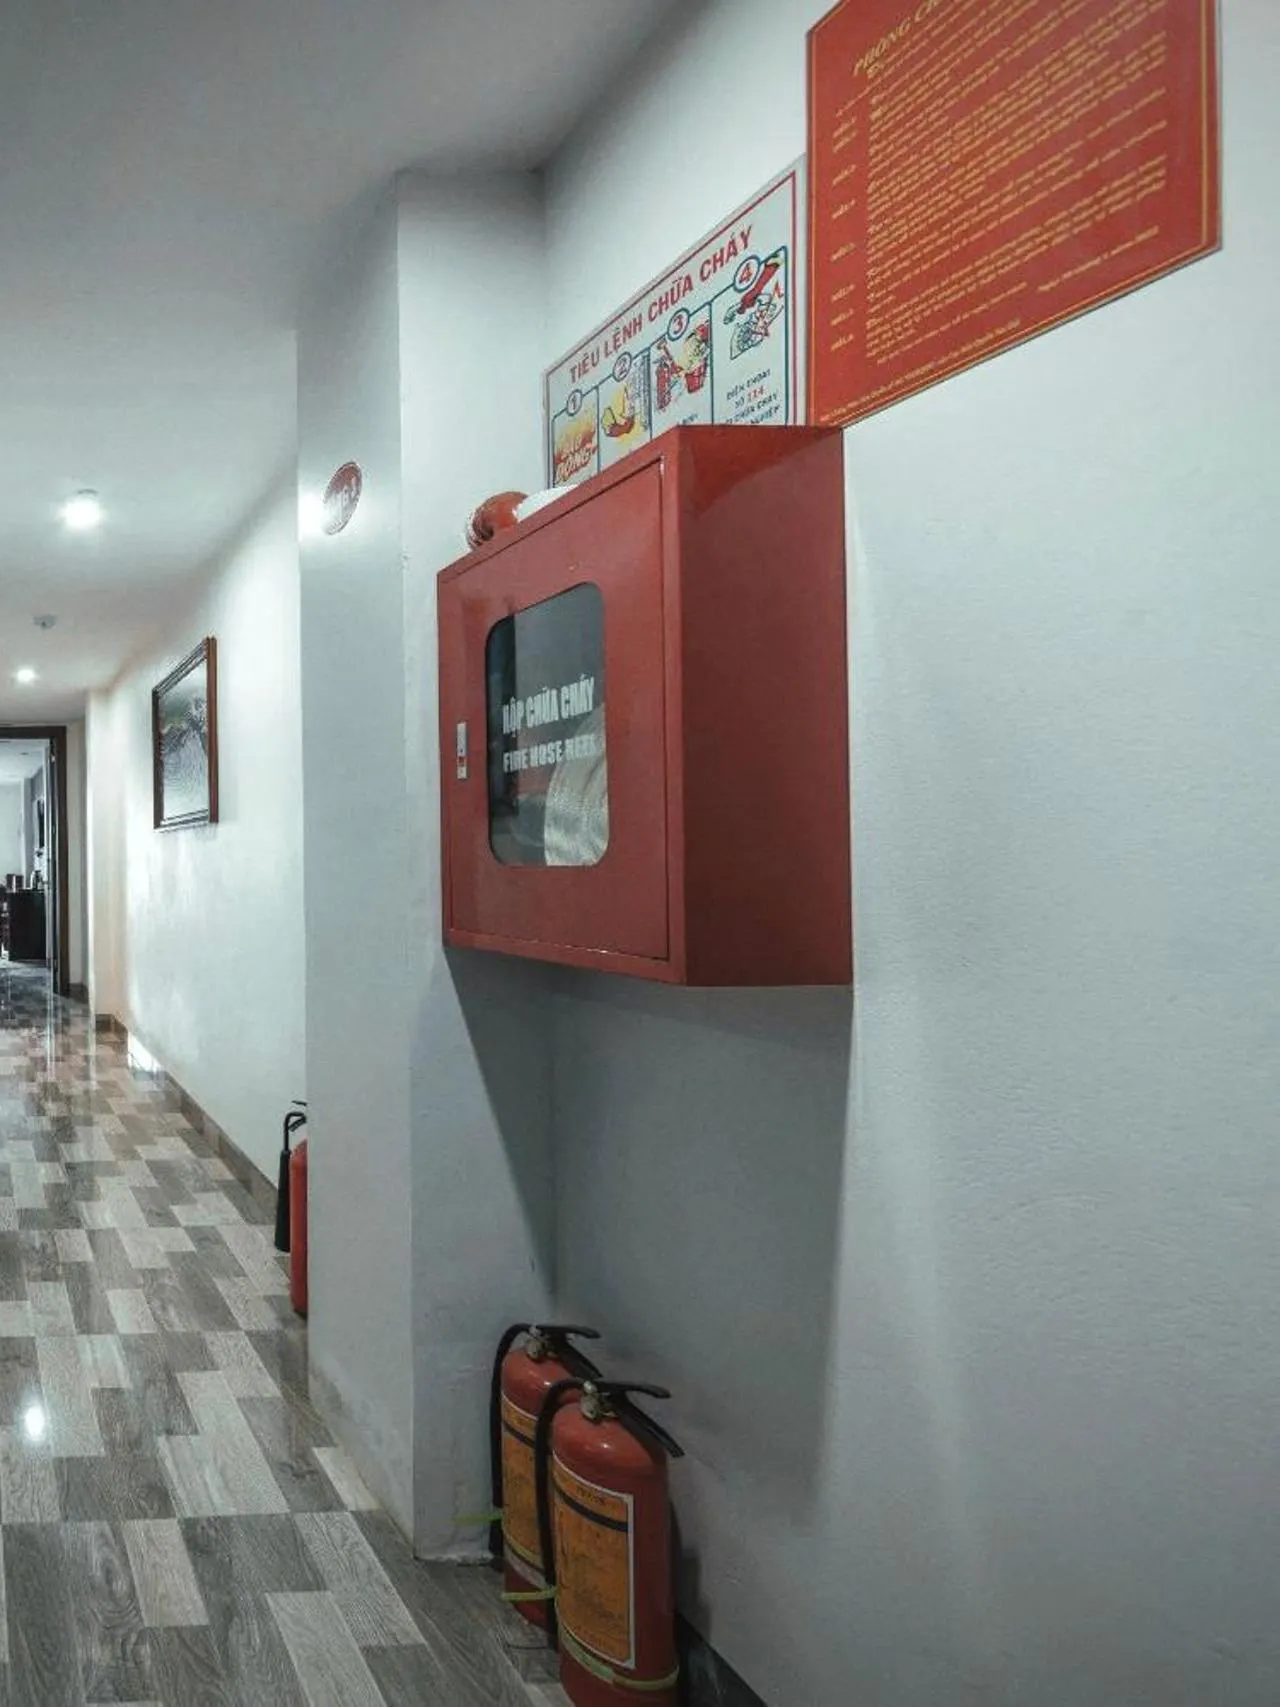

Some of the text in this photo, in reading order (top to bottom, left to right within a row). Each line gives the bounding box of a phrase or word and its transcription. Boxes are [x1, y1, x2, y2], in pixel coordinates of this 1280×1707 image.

[700, 224, 752, 282] CHÁY
[502, 748, 529, 773] FIRE
[530, 739, 563, 767] HOSE
